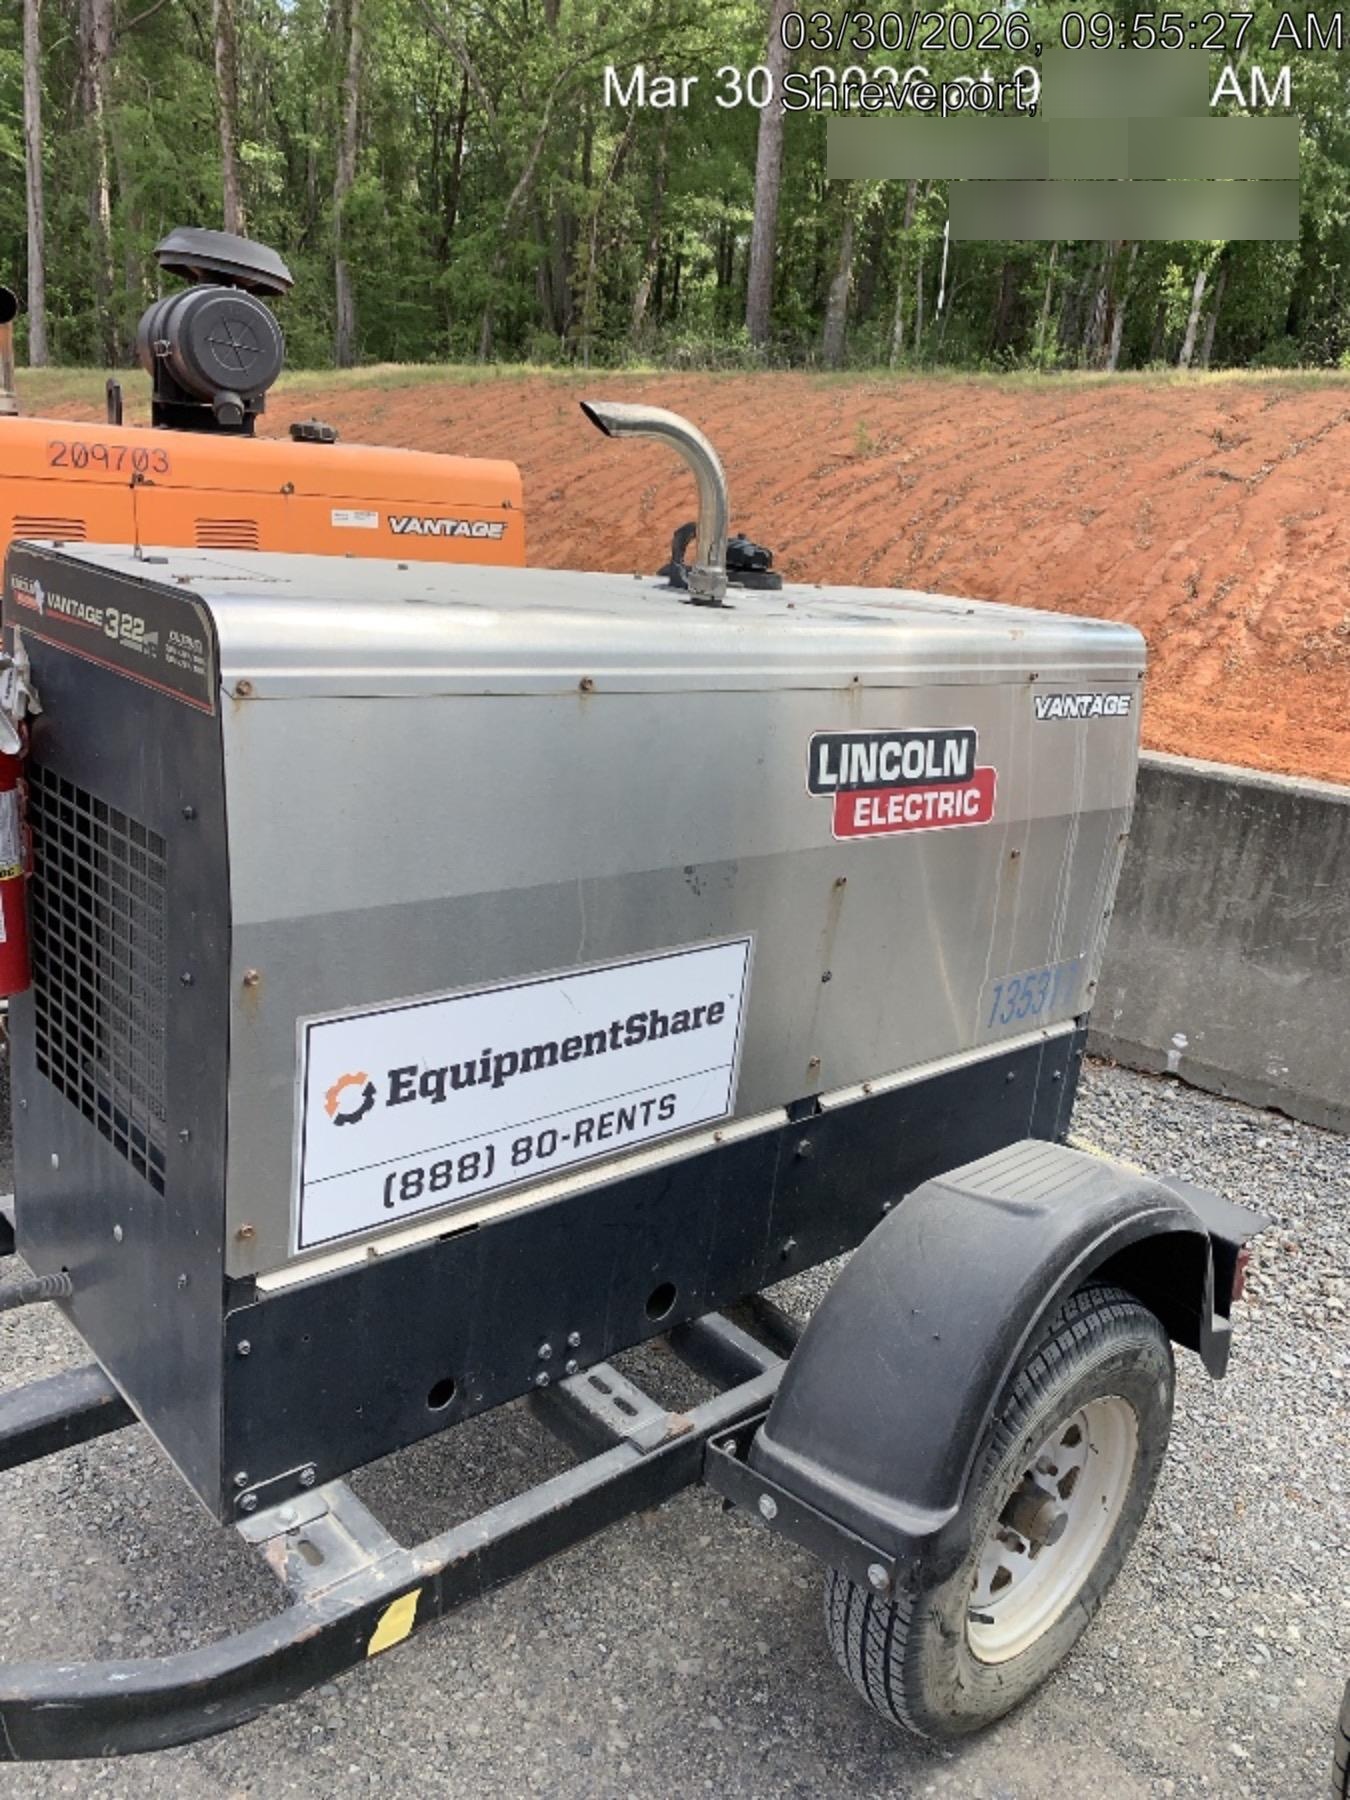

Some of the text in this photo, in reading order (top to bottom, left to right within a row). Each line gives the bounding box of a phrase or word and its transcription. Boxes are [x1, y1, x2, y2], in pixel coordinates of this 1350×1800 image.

[49, 440, 170, 474] 209703
[388, 516, 507, 540] VANTAGE
[46, 591, 104, 627] VANTAGE
[103, 607, 145, 643] 322
[1034, 692, 1134, 721] VANTAGE
[818, 737, 970, 786] LINCOLN
[853, 788, 981, 828] ELECTRIC
[386, 1000, 726, 1107] EquipmentShare
[383, 1093, 678, 1209] (888) 80-RENTS
